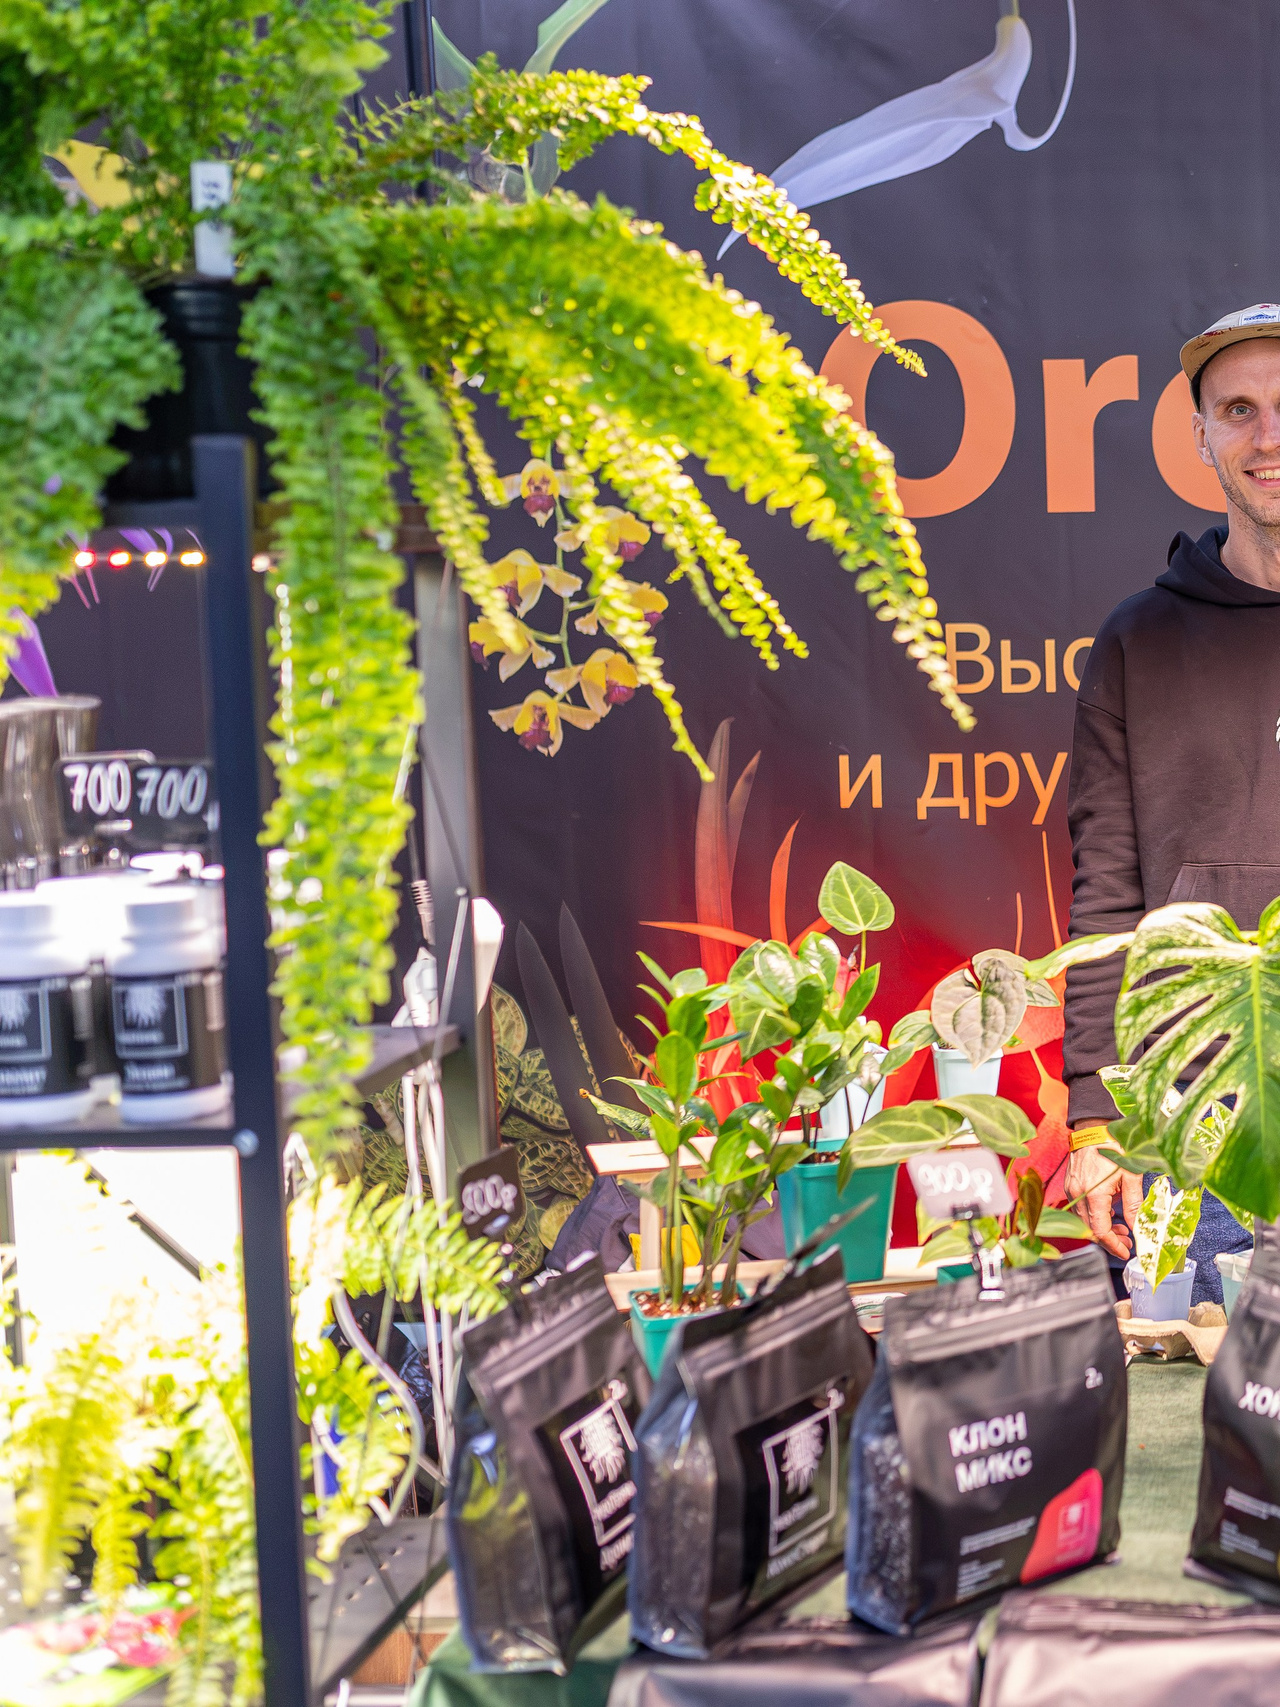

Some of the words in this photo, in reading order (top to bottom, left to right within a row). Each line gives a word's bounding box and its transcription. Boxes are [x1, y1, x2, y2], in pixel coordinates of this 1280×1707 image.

[944, 622, 1095, 694] Выс
[63, 760, 132, 816] 700
[838, 753, 883, 809] и
[916, 750, 1068, 826] дру
[948, 1410, 1029, 1458] КЛОН
[954, 1446, 1034, 1494] МИКС
